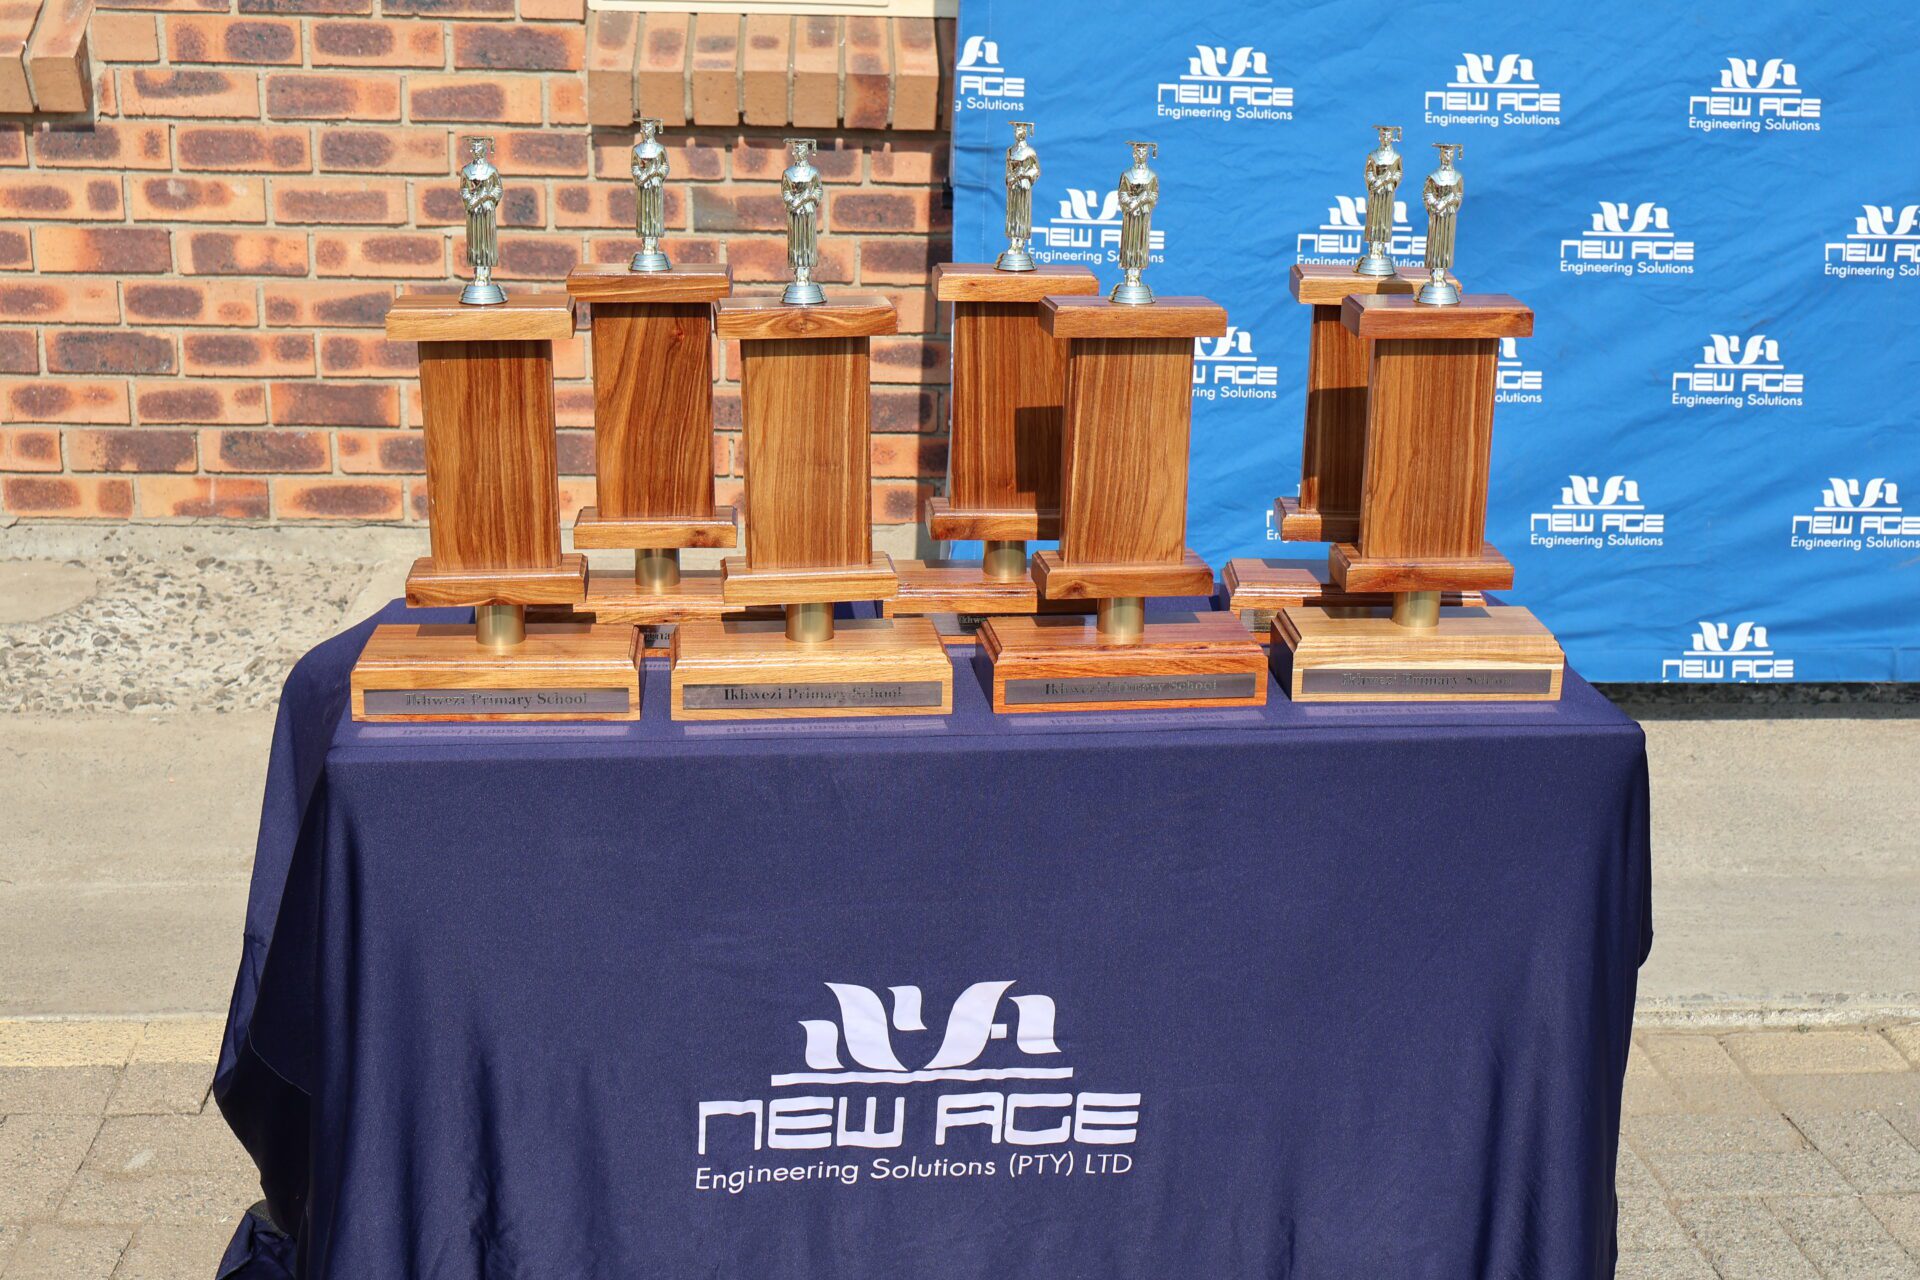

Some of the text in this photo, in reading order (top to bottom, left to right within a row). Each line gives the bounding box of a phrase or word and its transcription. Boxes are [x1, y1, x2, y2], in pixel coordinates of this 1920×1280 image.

[960, 75, 1025, 98] AGE
[1157, 83, 1294, 107] NEW AGE
[966, 96, 1025, 111] Solutions
[1424, 91, 1561, 113] NEW AGE
[1689, 95, 1822, 118] NEW AGE
[1157, 104, 1293, 121] Engineering Solutions
[1424, 111, 1561, 127] Engineering Solutions
[1688, 116, 1821, 133] Engineering Solutions
[1100, 228, 1165, 250] AE
[1296, 233, 1362, 254] NEW
[1027, 247, 1103, 264] Engineering
[1560, 239, 1695, 261] NEW AGE
[1824, 242, 1887, 263] NEW
[1560, 260, 1694, 276] Engineering Solutions
[1824, 263, 1895, 279] Engineering
[1213, 365, 1278, 386] AGE
[1496, 369, 1543, 390] GE
[1672, 372, 1804, 393] NEW AGE
[1220, 385, 1277, 399] Solutions
[1494, 389, 1543, 403] olutions
[1672, 392, 1803, 408] Engineering Solutions
[1530, 513, 1665, 533] NEW AGE
[1792, 515, 1920, 536] NEW AGE
[1530, 533, 1664, 549] Engineering Solutions
[1791, 535, 1920, 551] Engineering Solutions
[1662, 659, 1794, 679] NEW AGE
[471, 693, 533, 709] Primary
[537, 692, 588, 706] School
[723, 687, 782, 701] Ikhwezi
[697, 1091, 1143, 1156] NEW AGE
[695, 1151, 1133, 1194] Engineering Solutions (PTY) LTD
